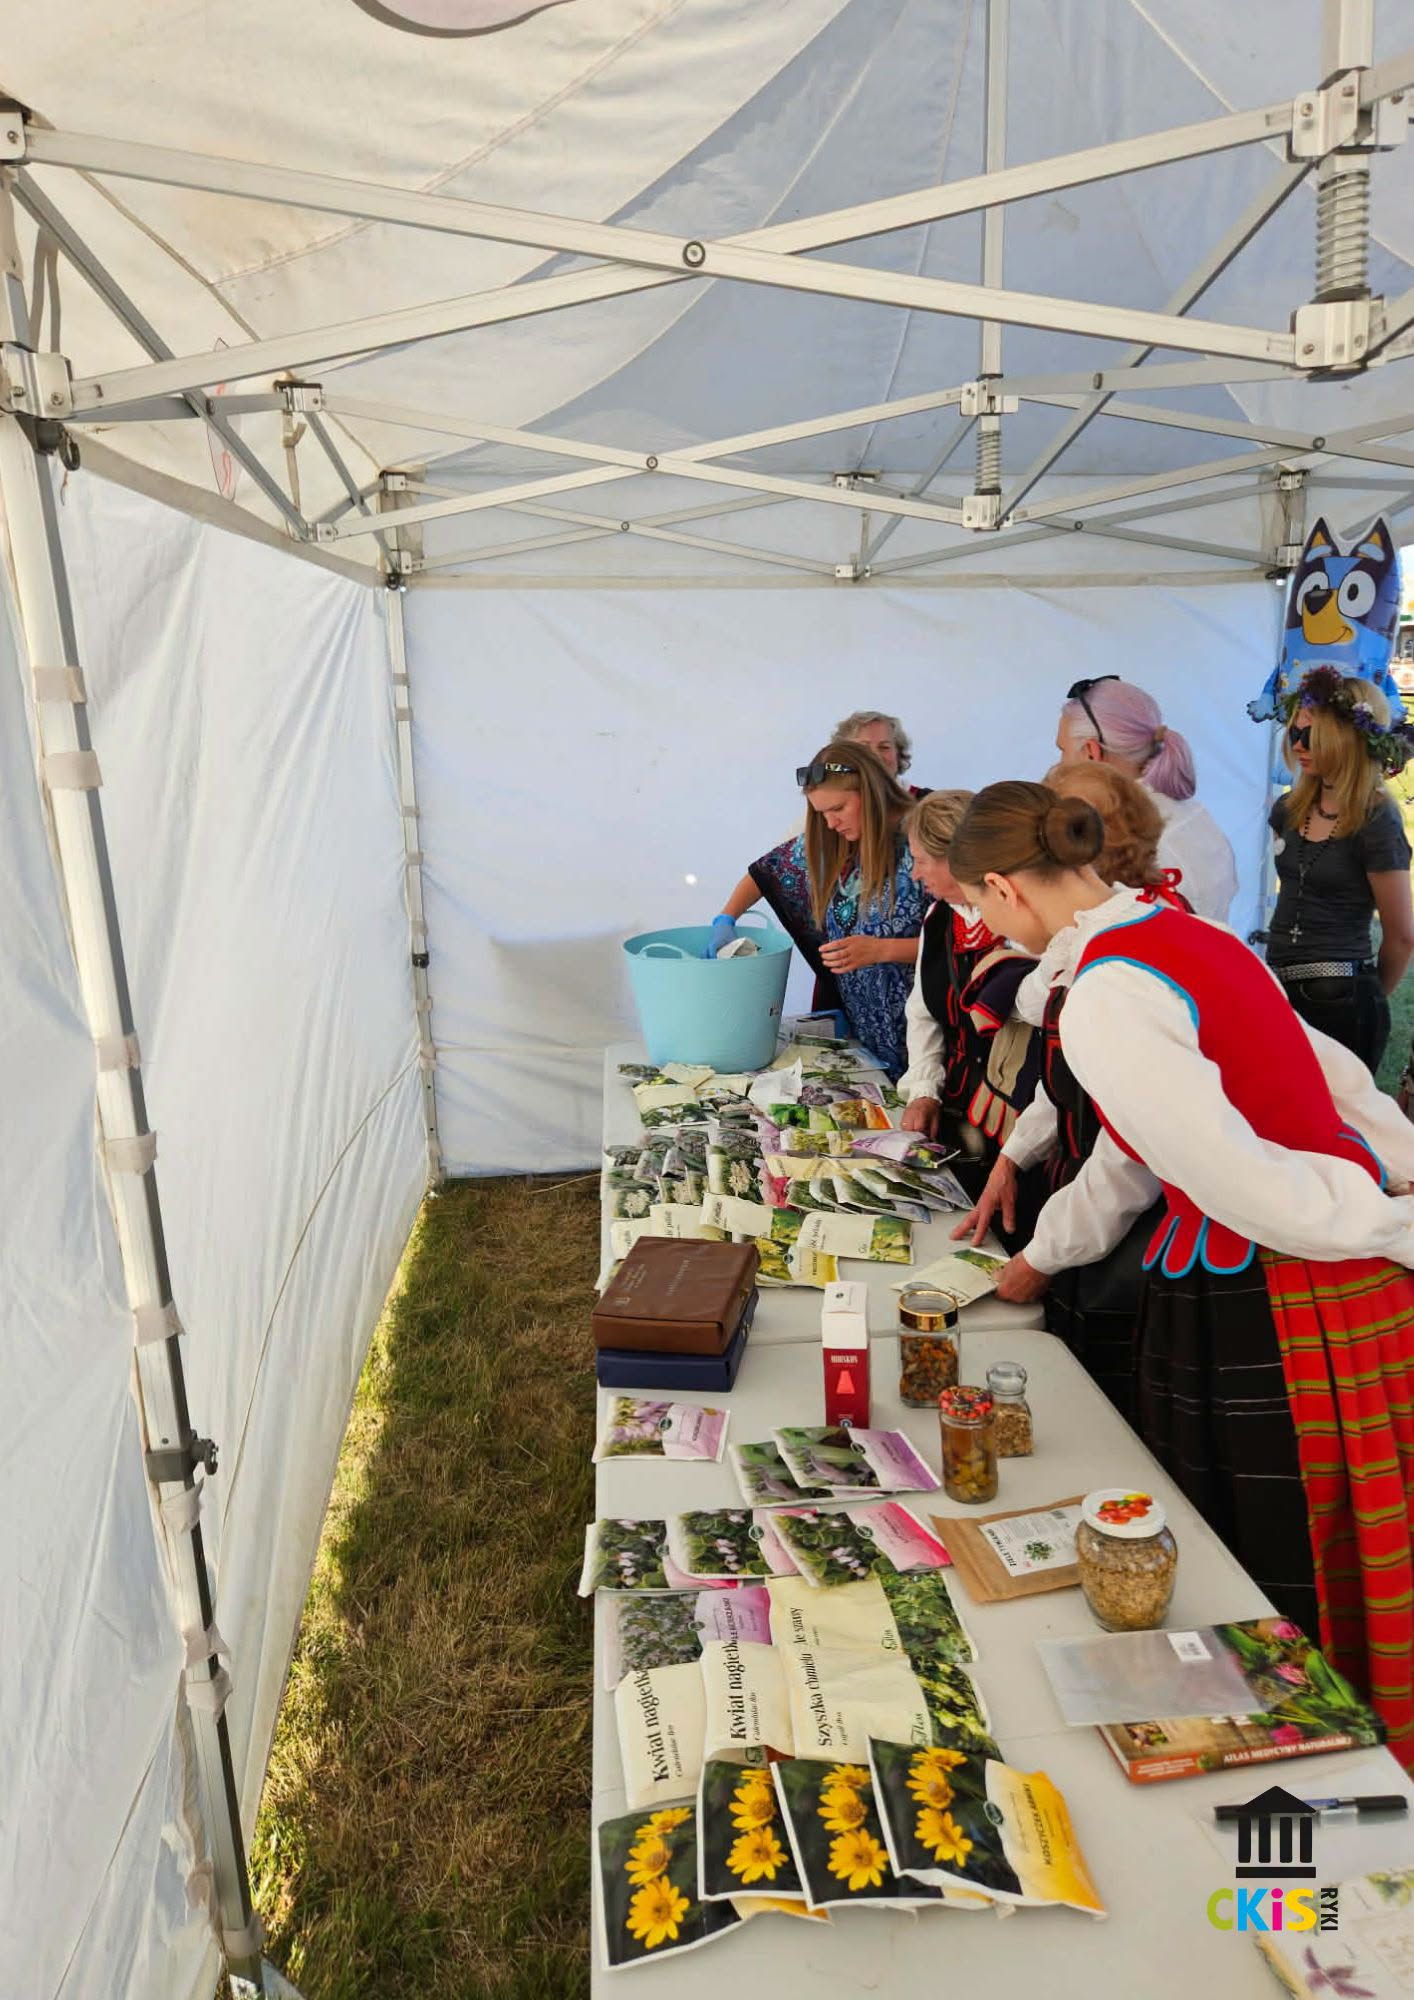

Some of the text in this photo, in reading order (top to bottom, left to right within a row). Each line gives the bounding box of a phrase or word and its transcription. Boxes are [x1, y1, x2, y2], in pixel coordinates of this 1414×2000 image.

[802, 1653, 821, 1690] chmielu
[728, 1695, 747, 1740] Kwiat
[811, 1693, 833, 1747] Szyszka
[647, 1731, 670, 1782] Kwiat
[1223, 1751, 1250, 1764] ATLAS
